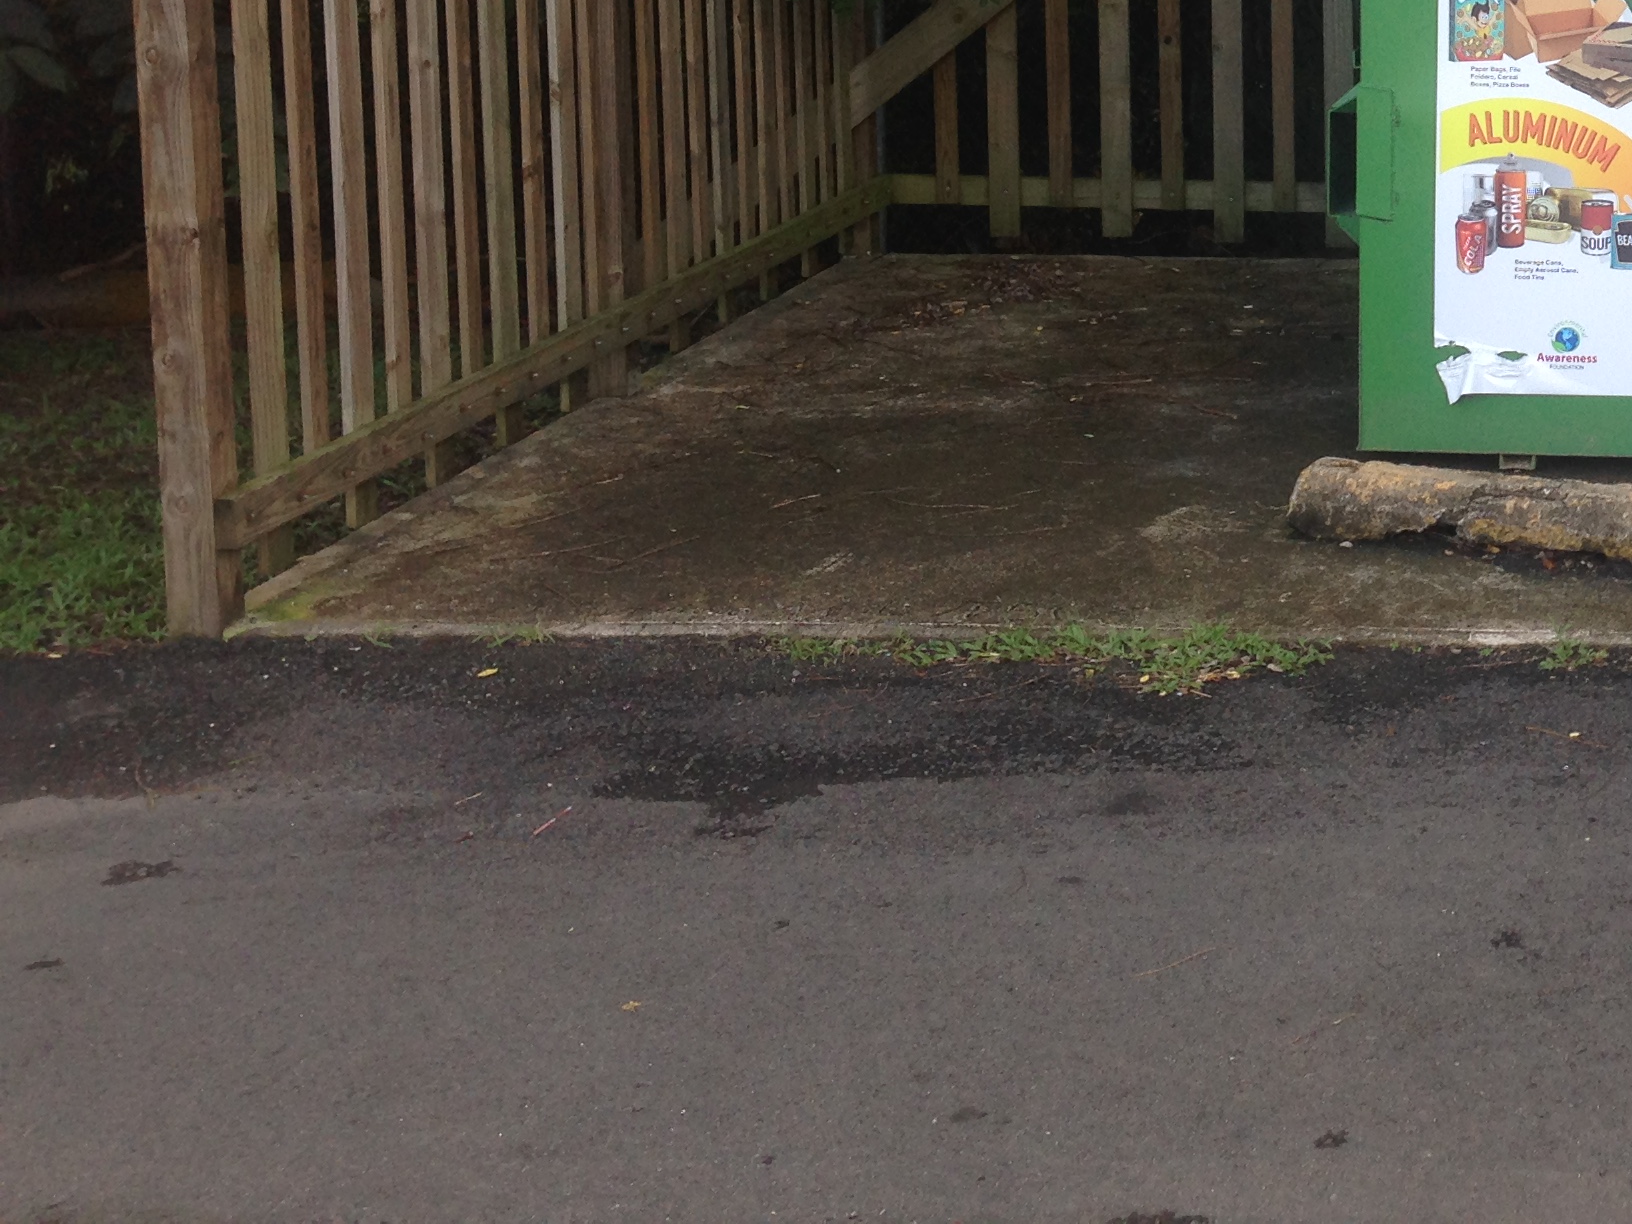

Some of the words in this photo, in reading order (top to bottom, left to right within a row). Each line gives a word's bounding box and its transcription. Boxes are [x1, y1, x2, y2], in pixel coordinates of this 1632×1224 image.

[1468, 110, 1621, 173] ALUMINUM
[1501, 183, 1522, 235] SPRAY
[1463, 234, 1483, 267] COLA
[1581, 236, 1611, 251] SOUP
[1536, 352, 1598, 364] Awareness
